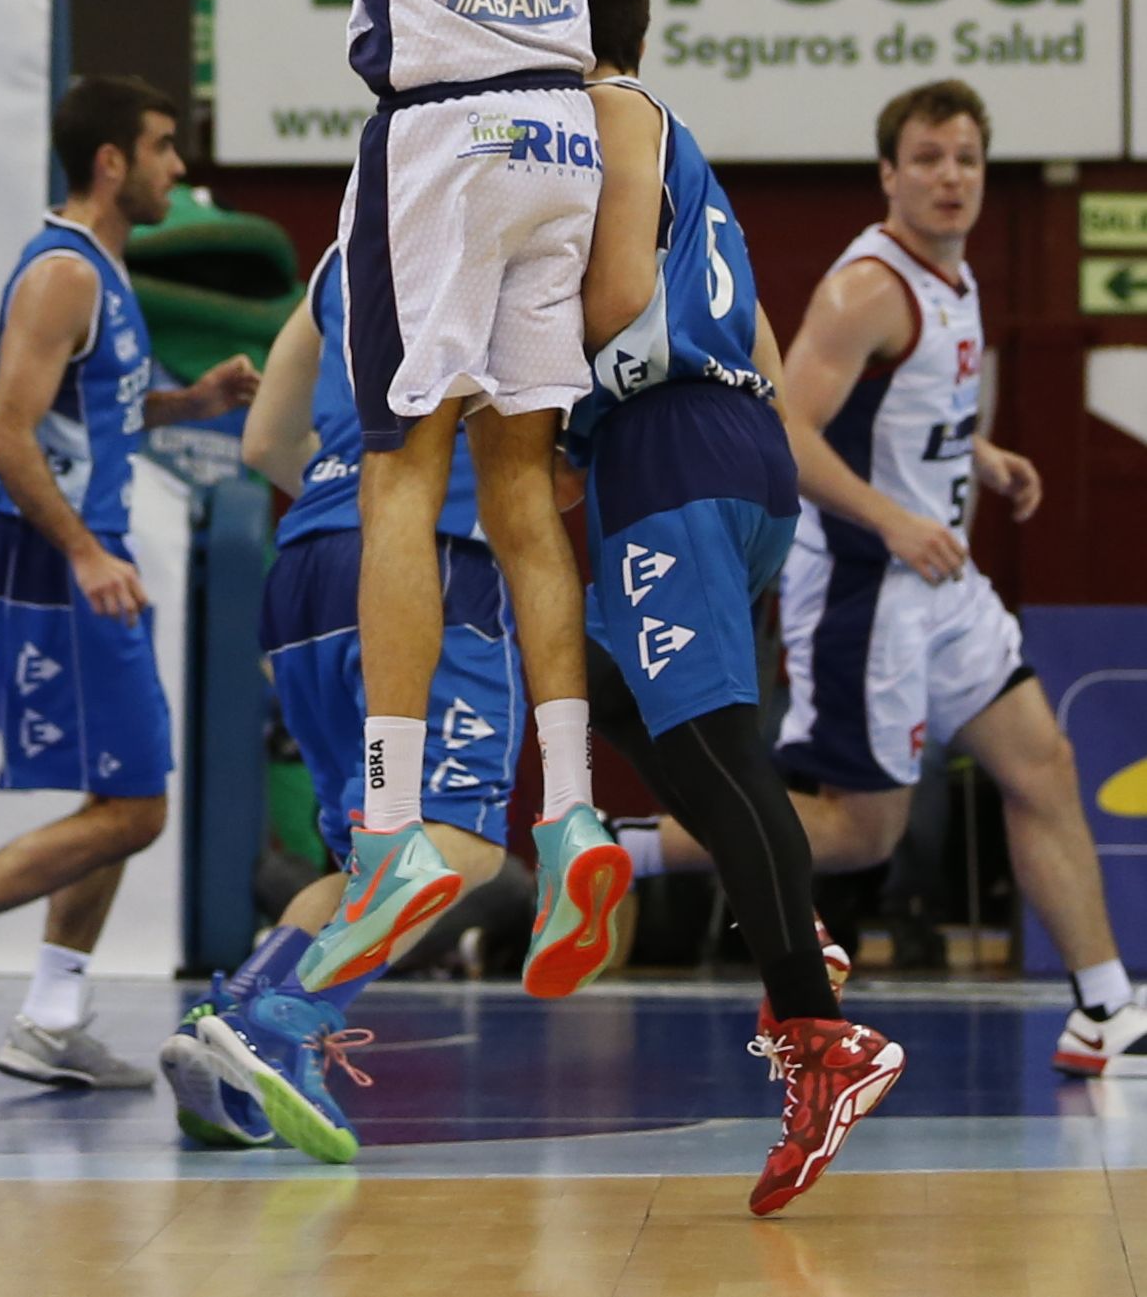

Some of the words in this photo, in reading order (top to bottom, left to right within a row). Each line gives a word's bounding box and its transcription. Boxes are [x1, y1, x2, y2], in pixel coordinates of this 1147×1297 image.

[663, 22, 859, 80] Seguros
[875, 22, 938, 65] de
[954, 20, 1085, 66] Salud
[369, 738, 385, 790] OBRA
